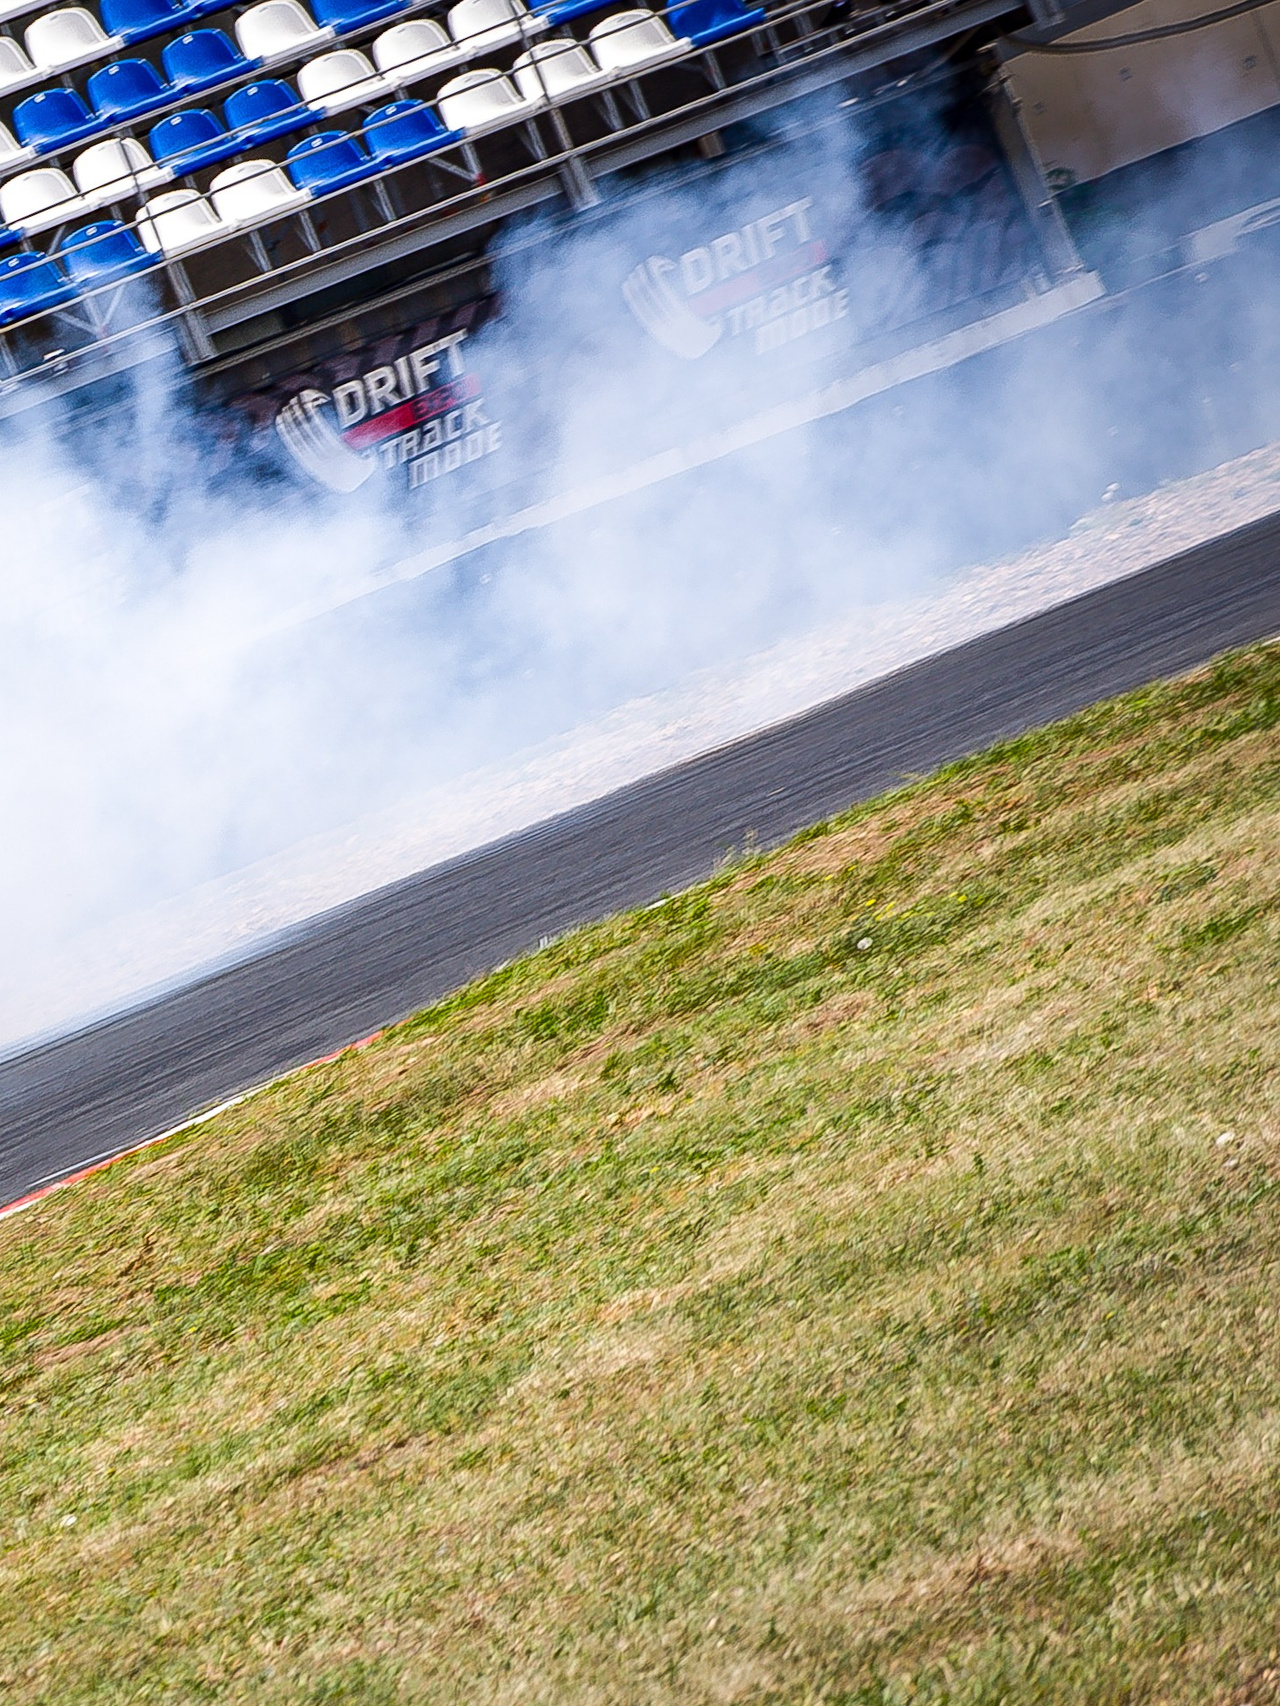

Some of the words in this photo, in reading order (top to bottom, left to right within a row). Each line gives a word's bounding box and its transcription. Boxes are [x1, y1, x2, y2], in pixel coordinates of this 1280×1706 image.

[679, 196, 812, 294] DRIFT
[331, 328, 469, 430] DRIFT
[379, 396, 491, 471] TRACK
[407, 420, 504, 490] MODE
